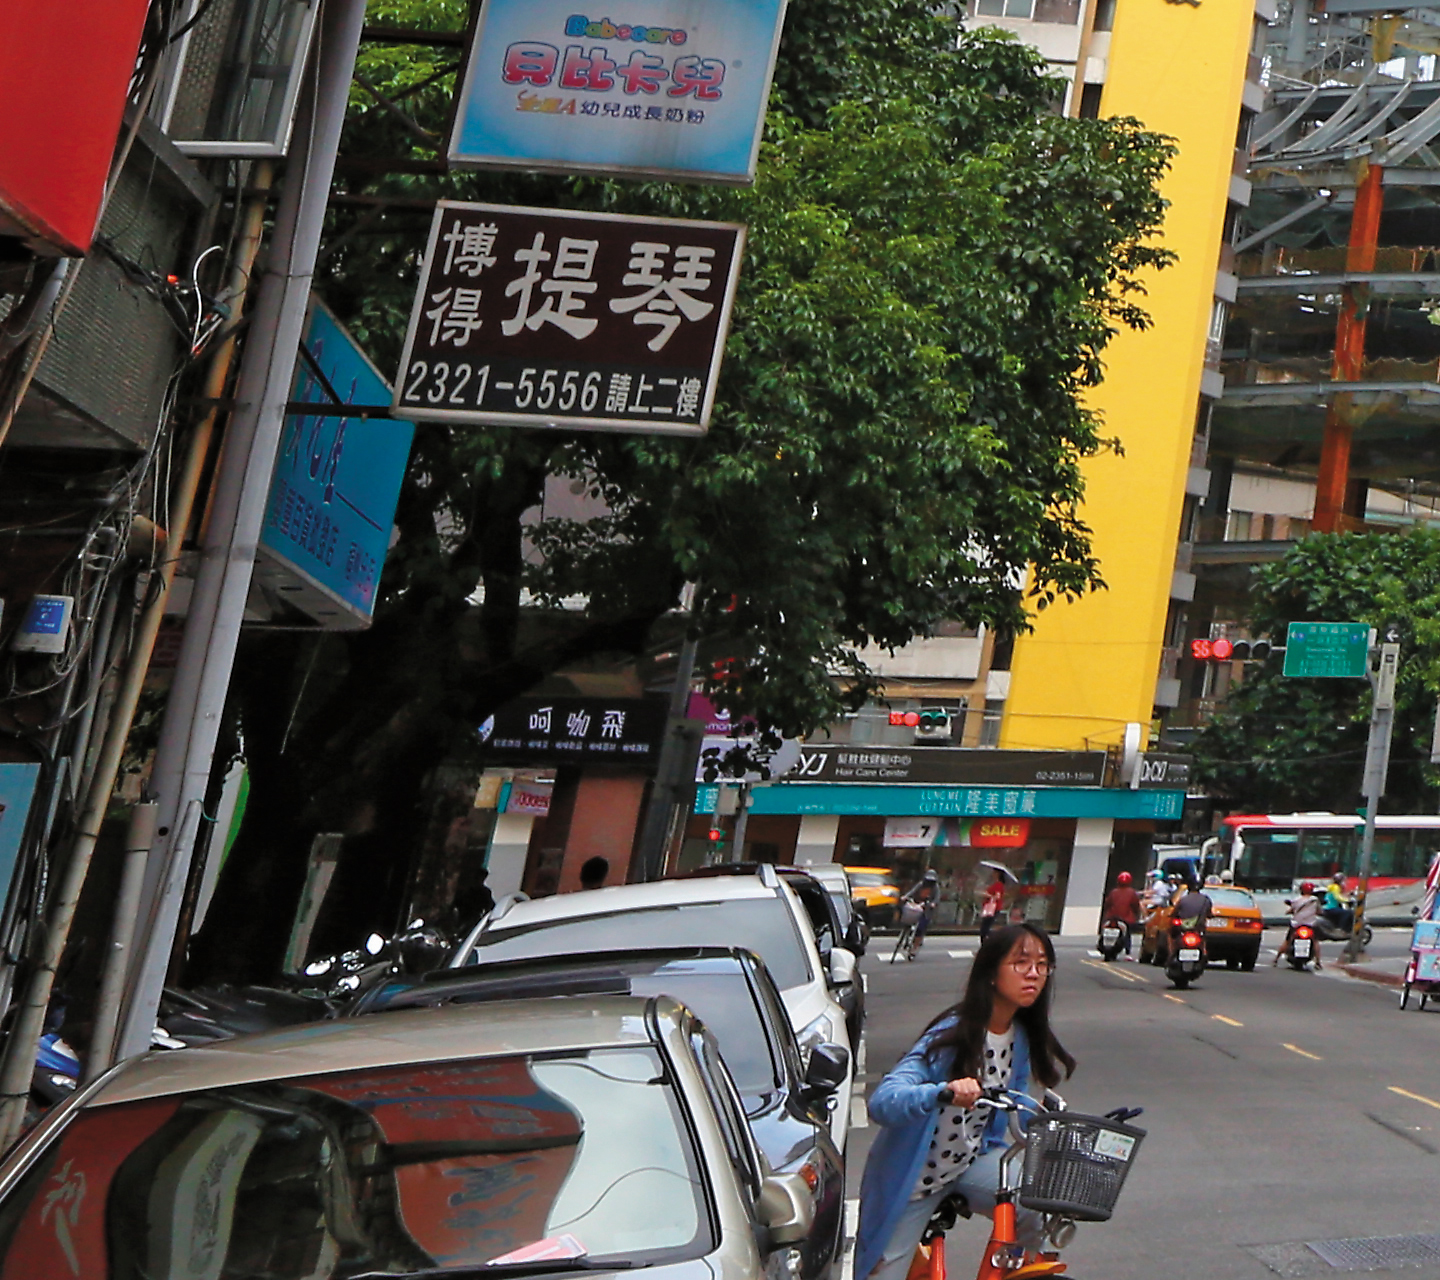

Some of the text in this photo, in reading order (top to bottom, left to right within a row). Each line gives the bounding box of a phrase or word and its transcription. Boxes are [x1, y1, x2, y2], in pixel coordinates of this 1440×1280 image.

[565, 14, 687, 45] Babecare
[502, 41, 726, 101] 貝比卡兒
[580, 100, 705, 124] 幼兒成長奶粉
[501, 231, 716, 353] 提琴
[405, 360, 601, 412] 2321-5556
[605, 372, 701, 418] 請上二樓
[529, 707, 625, 739] 呵咖飛
[835, 768, 909, 777] Hair Care Center
[980, 825, 1020, 837] SALE
